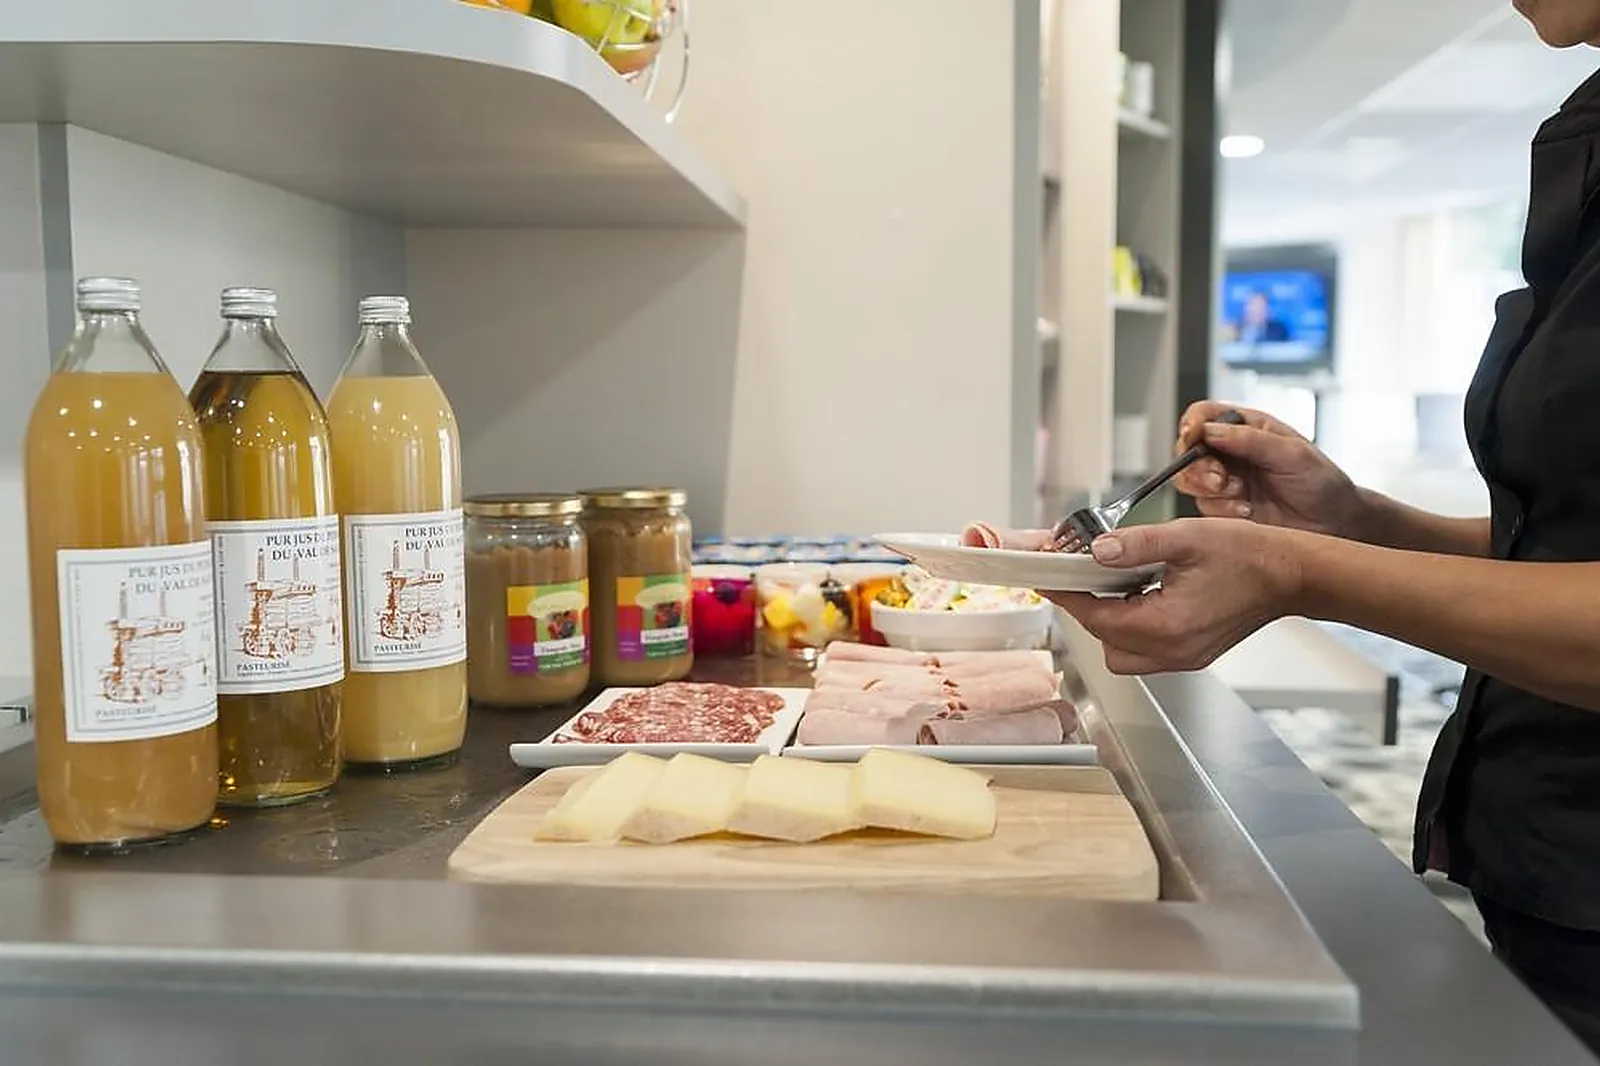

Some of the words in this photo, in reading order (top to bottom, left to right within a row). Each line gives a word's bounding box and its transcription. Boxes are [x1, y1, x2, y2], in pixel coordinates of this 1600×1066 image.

[405, 527, 427, 538] PUR
[428, 526, 445, 538] JUS
[266, 534, 292, 546] PUR
[293, 532, 313, 547] JUS
[405, 540, 422, 551] DU
[272, 548, 291, 561] DU
[296, 547, 319, 559] VAL
[128, 565, 158, 578] PUR
[135, 582, 157, 594] DU
